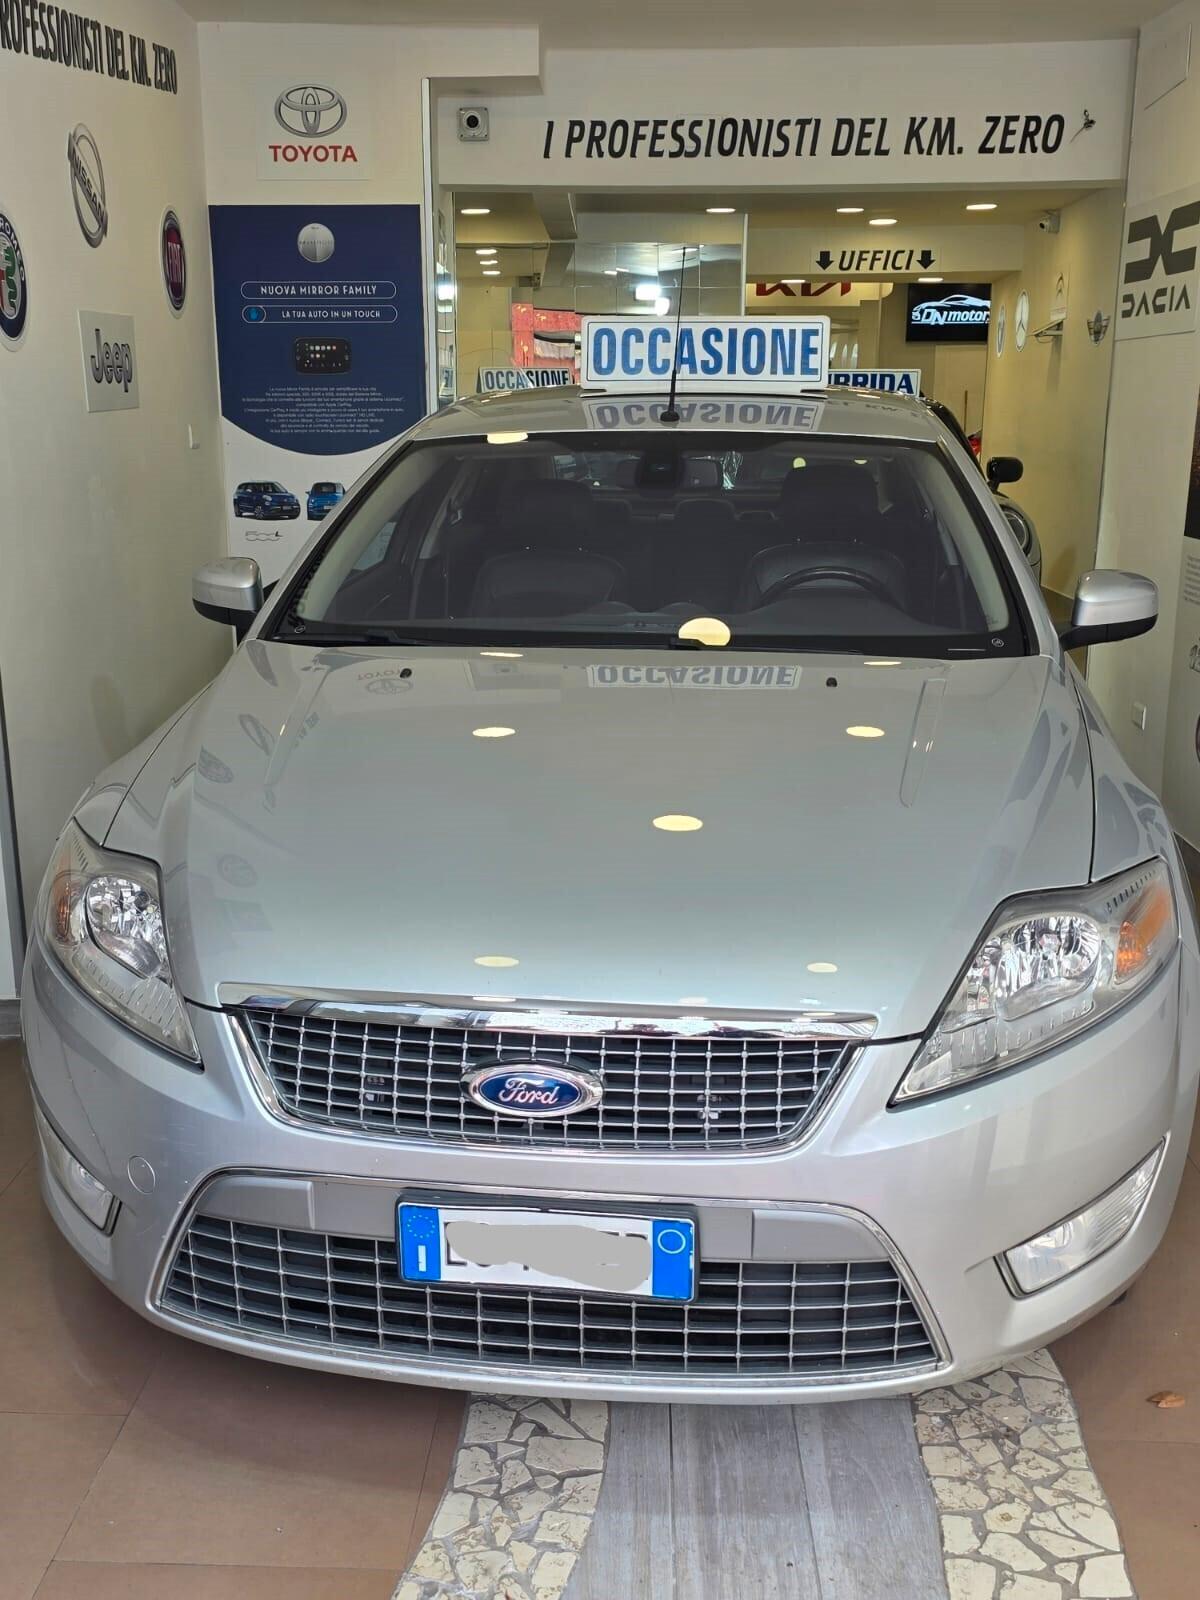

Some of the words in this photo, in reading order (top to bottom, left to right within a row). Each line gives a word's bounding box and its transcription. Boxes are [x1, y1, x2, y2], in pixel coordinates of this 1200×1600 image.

[0, 0, 104, 74] ROFESSIONISTI
[105, 25, 129, 81] DEL
[129, 34, 152, 87] KM.
[152, 42, 178, 95] ZERO
[268, 144, 358, 163] TOYOTA
[543, 119, 555, 158] I
[565, 117, 821, 158] PROFESSIONISTI
[831, 117, 891, 156] DEL
[904, 116, 964, 155] KM.
[978, 114, 1065, 155] ZERO
[72, 148, 105, 217] NISSAN
[168, 240, 182, 283] FIAT
[838, 249, 914, 271] UFFICI
[260, 285, 296, 295] NUOVA
[300, 285, 339, 295] MIRROR
[343, 285, 377, 295] FAMILY
[1121, 283, 1191, 319] DACIA
[282, 310, 290, 318] LA
[292, 310, 306, 318] TUA
[308, 310, 329, 318] AUTO
[330, 310, 339, 318] IN
[341, 310, 352, 318] UN
[354, 310, 380, 318] TOUCH
[91, 328, 133, 393] Jeep
[593, 327, 820, 376] OCCASIONE
[484, 369, 569, 390] OCCASIONE
[498, 1077, 559, 1105] Ford
